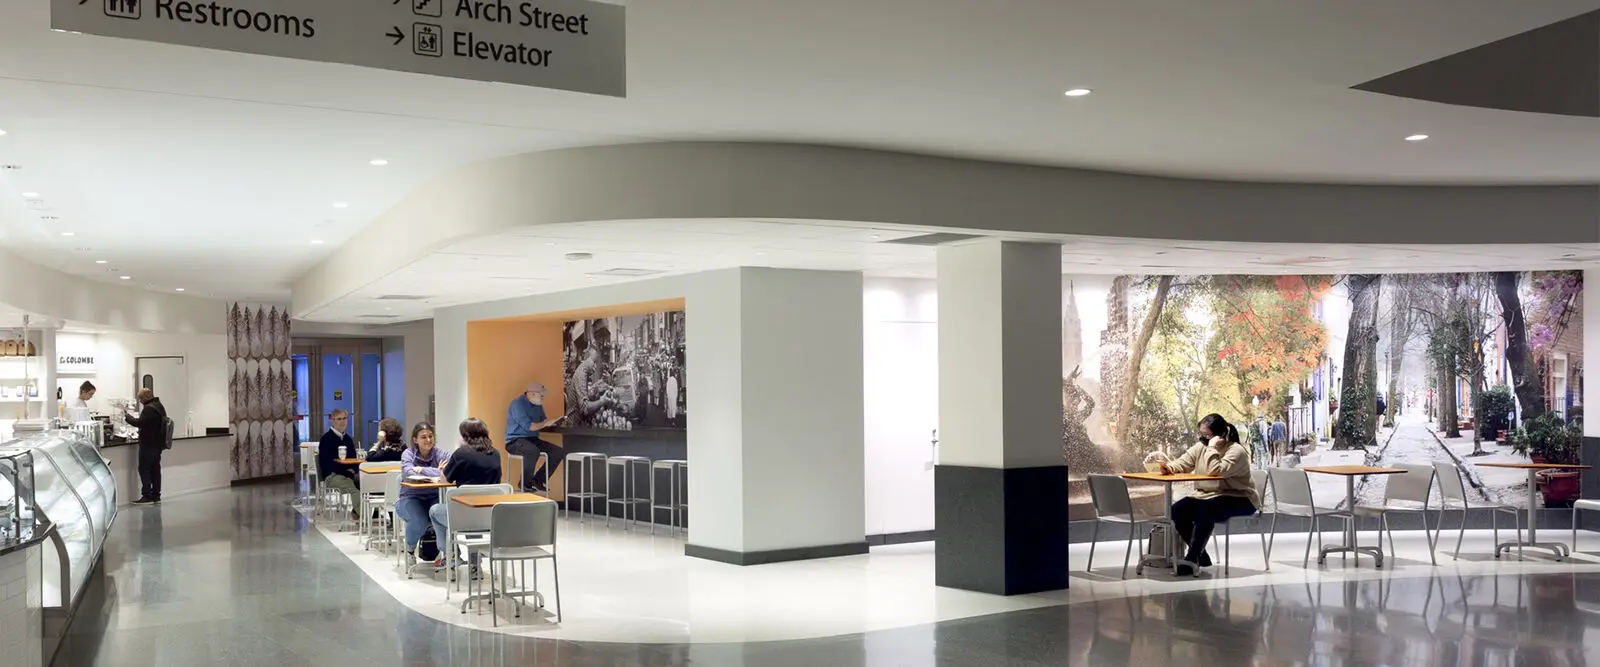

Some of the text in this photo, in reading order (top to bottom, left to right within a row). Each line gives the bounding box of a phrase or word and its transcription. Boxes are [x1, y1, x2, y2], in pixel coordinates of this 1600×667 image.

[155, 0, 315, 38] Restrooms
[454, 0, 589, 35] Arch Street
[452, 31, 552, 67] Elevator
[66, 356, 94, 364] COLOMBE
